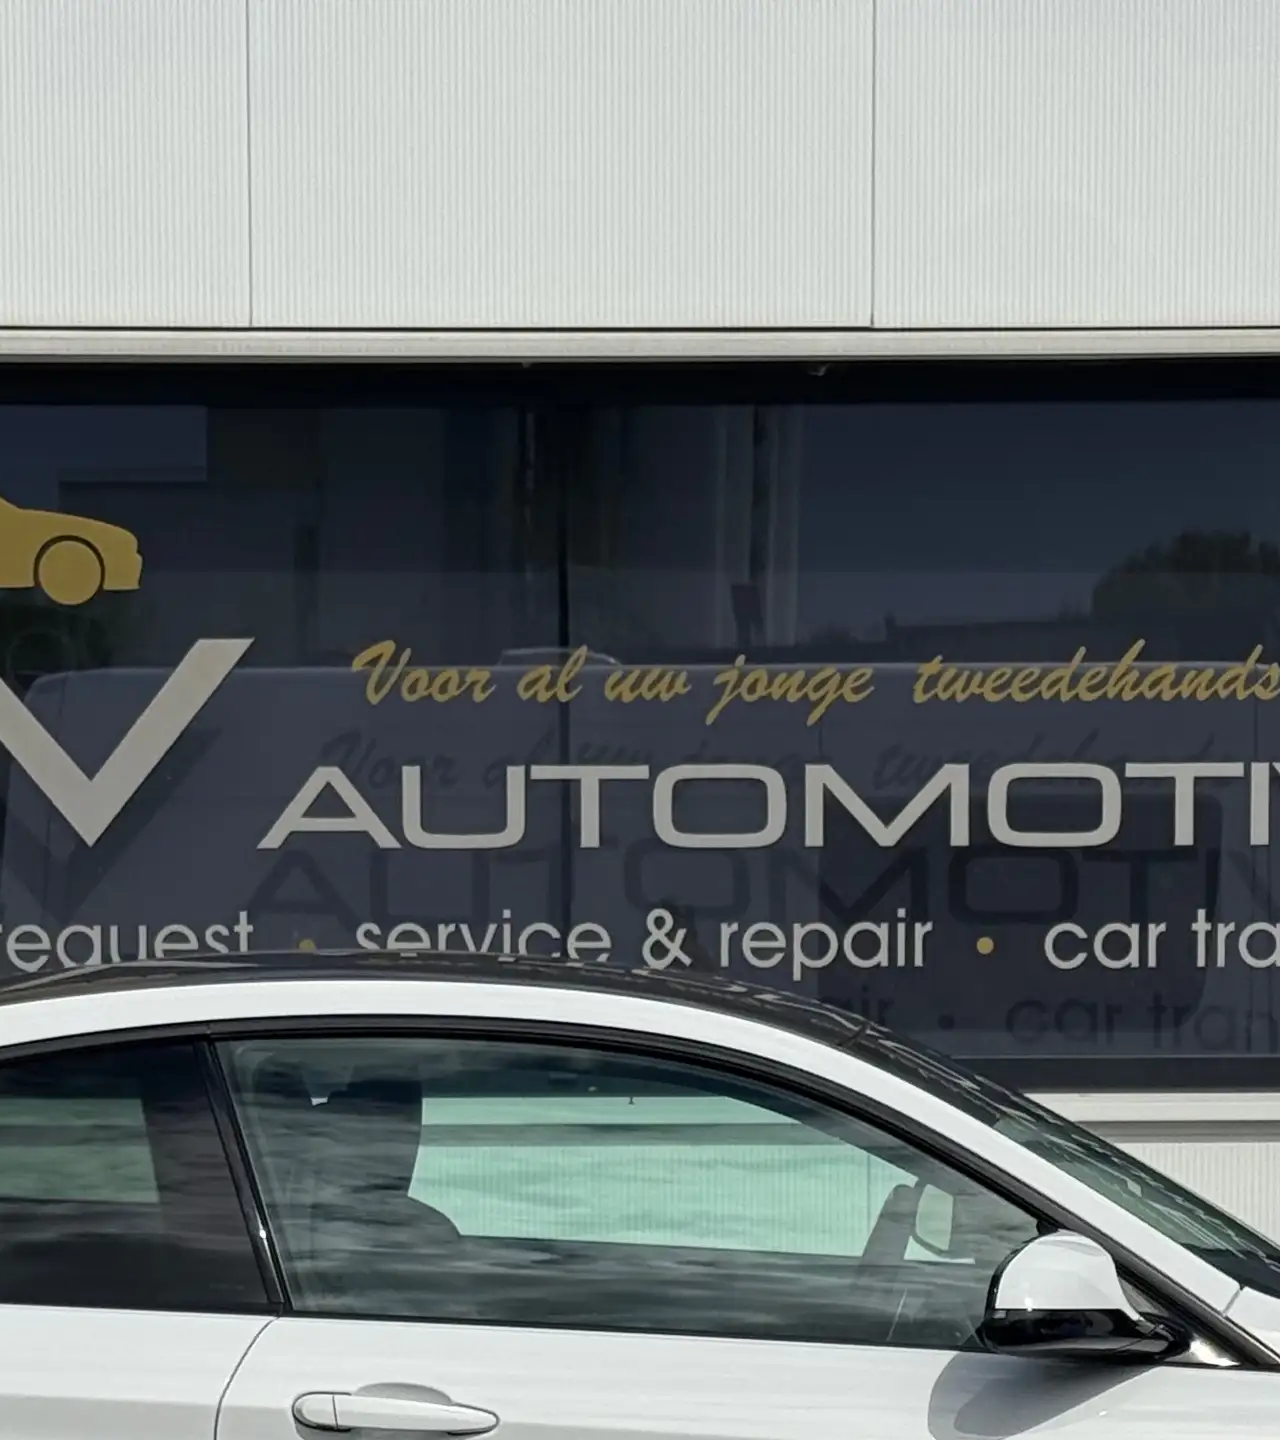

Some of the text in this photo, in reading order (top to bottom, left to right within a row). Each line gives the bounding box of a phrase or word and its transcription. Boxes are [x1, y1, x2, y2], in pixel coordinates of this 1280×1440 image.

[351, 640, 495, 706] Voor
[516, 646, 587, 704] al
[604, 666, 691, 704] uw
[705, 655, 874, 726] jonge
[356, 908, 612, 962] service
[641, 908, 708, 971] &
[720, 907, 933, 981] repair
[1044, 922, 1166, 969] car
